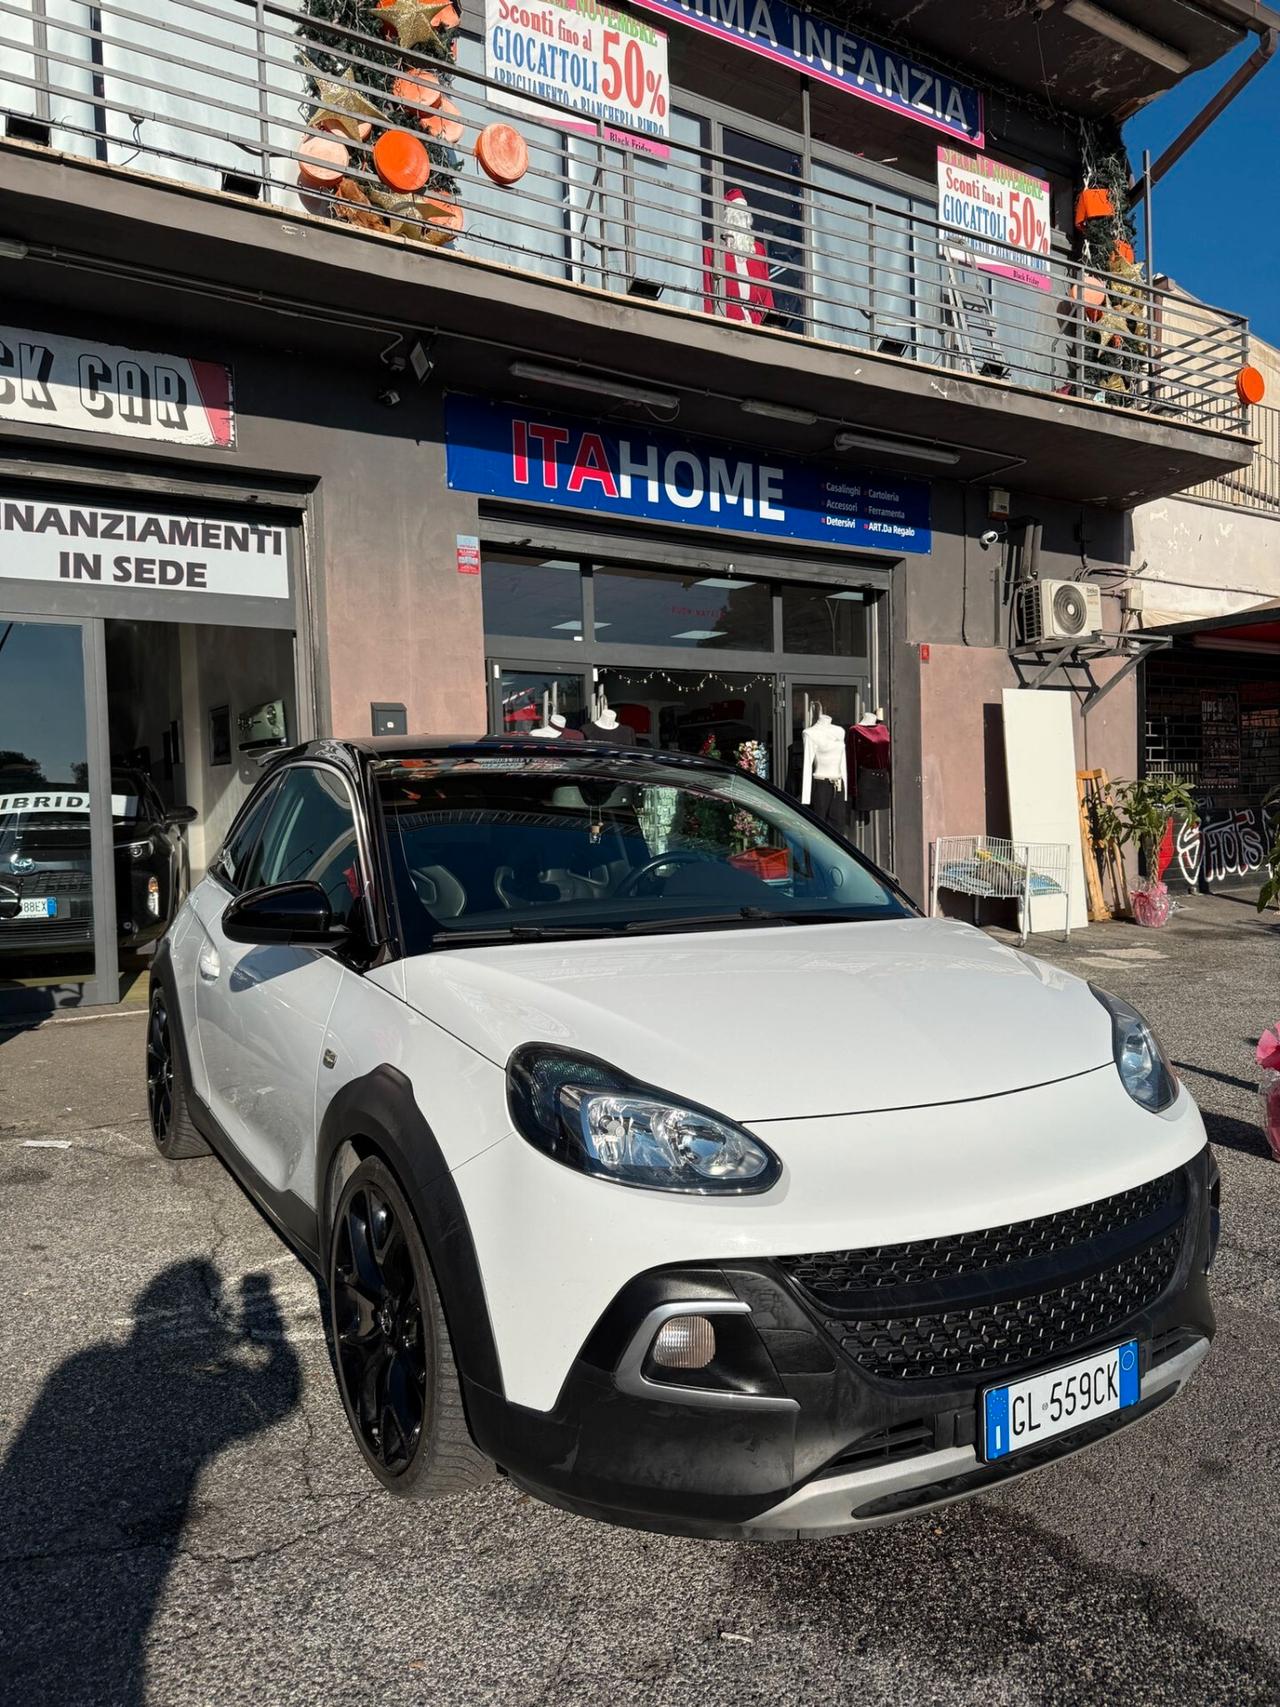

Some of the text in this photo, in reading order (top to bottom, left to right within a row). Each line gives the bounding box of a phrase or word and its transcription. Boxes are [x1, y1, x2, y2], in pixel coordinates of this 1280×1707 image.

[493, 25, 598, 95] GIOCATTOLI
[499, 0, 666, 117] Sconti fino al 50%
[792, 14, 972, 130] INFANZIA
[609, 132, 629, 146] Black
[943, 194, 1007, 241] GIOCATTOLI
[946, 167, 980, 200] Sconti
[982, 184, 995, 205] fino
[996, 191, 1003, 208] al
[1008, 191, 1049, 255] 50%
[78, 353, 188, 431] CAR
[512, 419, 785, 521] ITAHOME
[826, 482, 861, 497] Casalinghi
[826, 499, 858, 512] Accessori
[868, 489, 900, 502] Cartoleria
[0, 503, 282, 556] NANZIAMENTI
[826, 516, 856, 529] Detersivi
[868, 505, 905, 519] Ferramenta
[893, 525, 916, 538] Regalo
[59, 551, 207, 589] IN SEDE
[1, 796, 90, 810] IBRID
